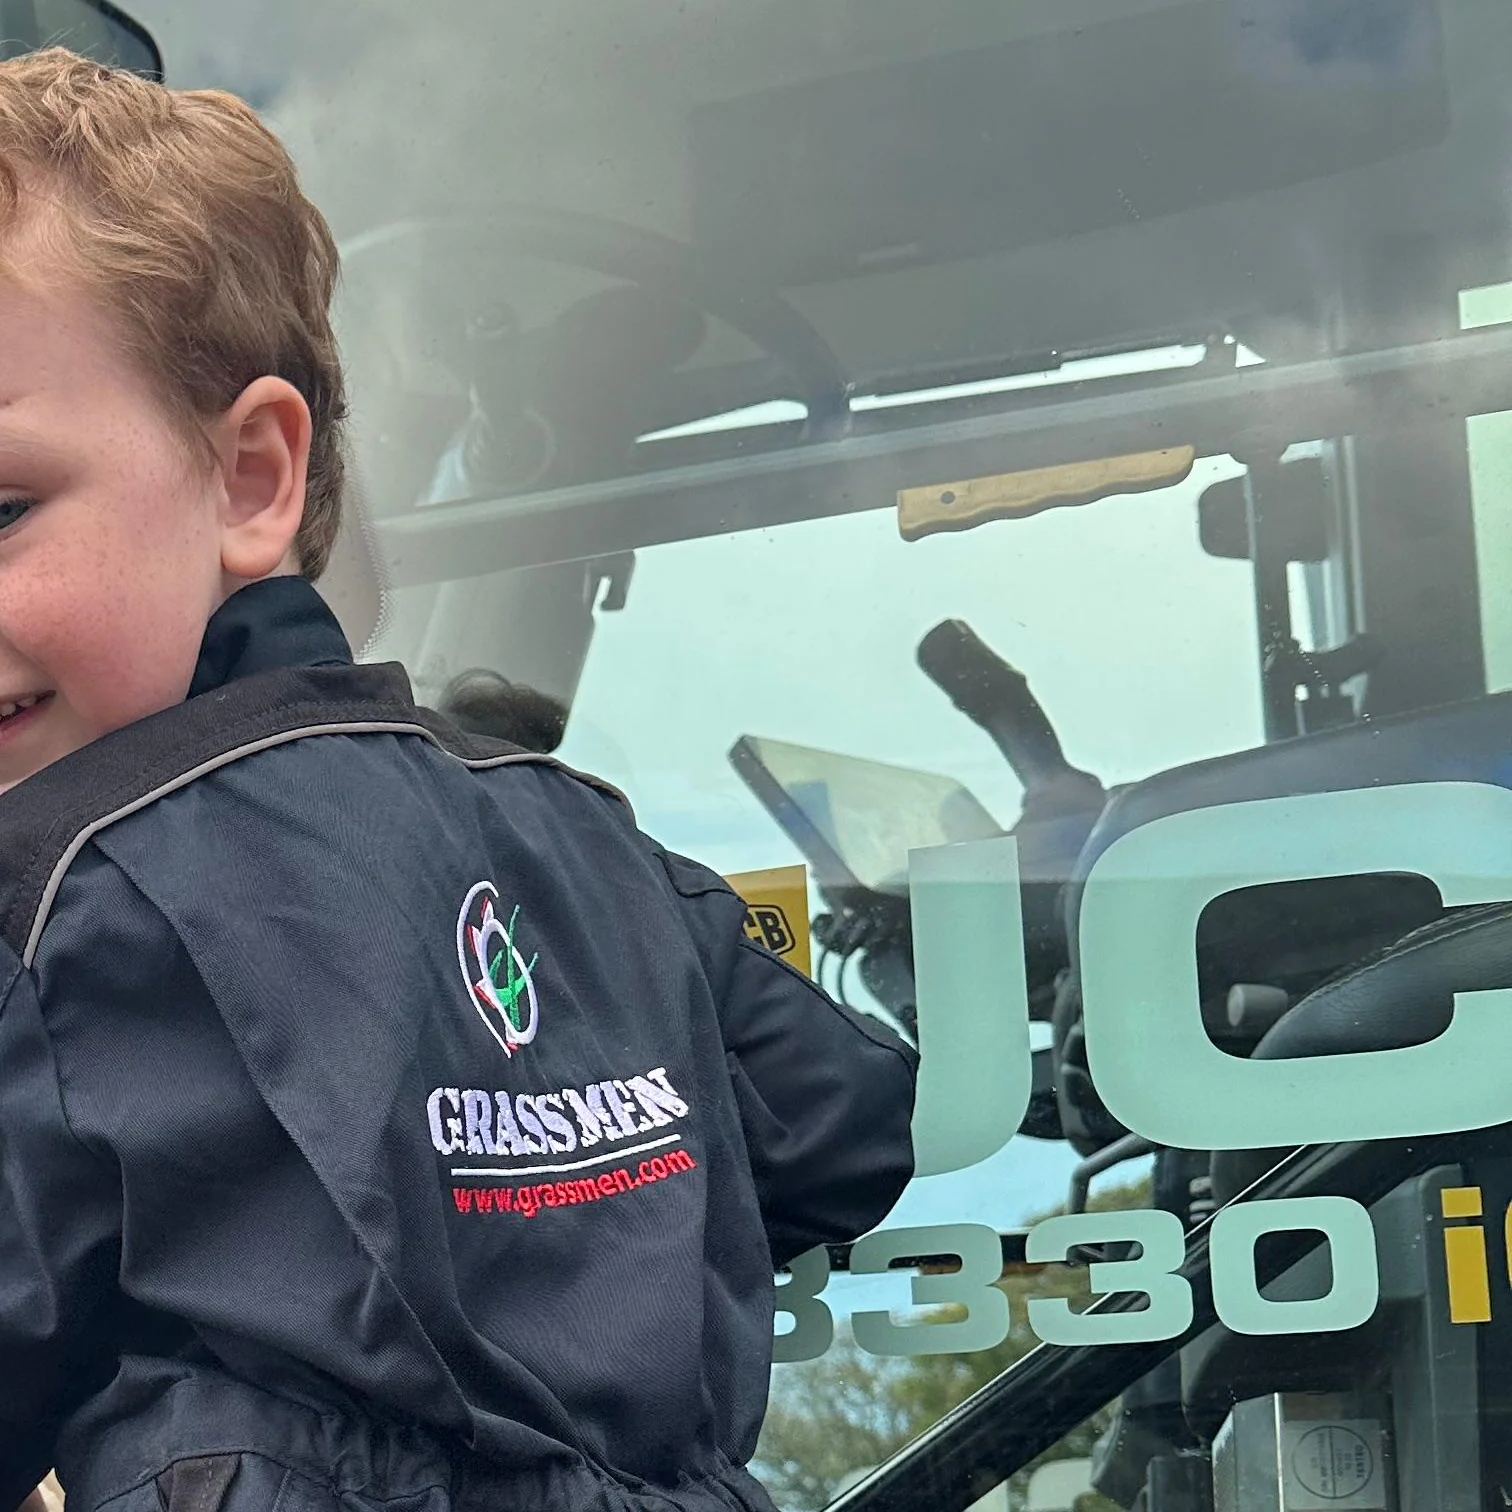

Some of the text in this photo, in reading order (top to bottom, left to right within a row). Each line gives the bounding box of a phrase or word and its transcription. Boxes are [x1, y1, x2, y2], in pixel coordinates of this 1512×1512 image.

[426, 1067, 689, 1155] GRASSMEN
[453, 1149, 696, 1218] www.grassmen.com
[1441, 1186, 1512, 1324] i
